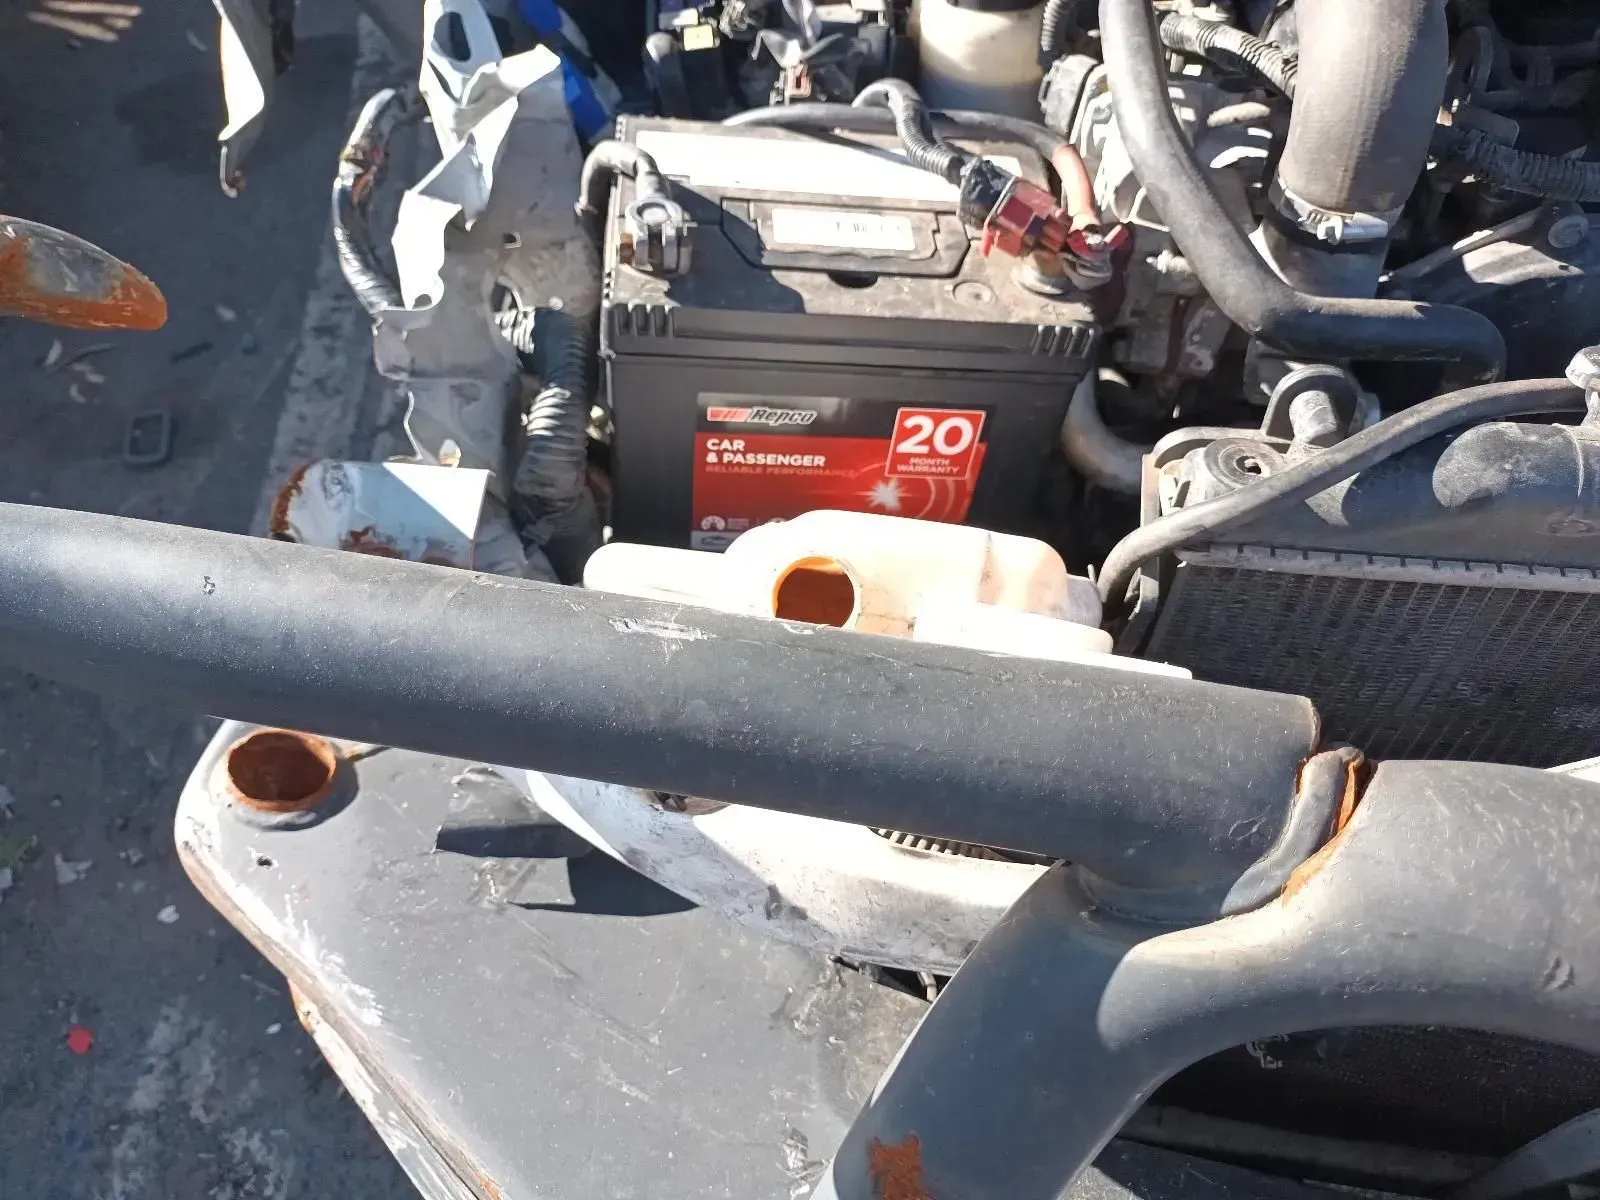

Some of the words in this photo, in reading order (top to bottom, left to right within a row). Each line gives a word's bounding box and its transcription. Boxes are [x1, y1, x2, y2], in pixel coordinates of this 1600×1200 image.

[748, 407, 816, 425] Repco
[896, 415, 973, 455] 20
[706, 438, 745, 451] CAR
[706, 452, 718, 463] &
[723, 453, 826, 466] PASSENGER
[909, 457, 950, 466] MONTH
[706, 465, 763, 474] RELIABLE
[897, 464, 960, 473] WARRANTY
